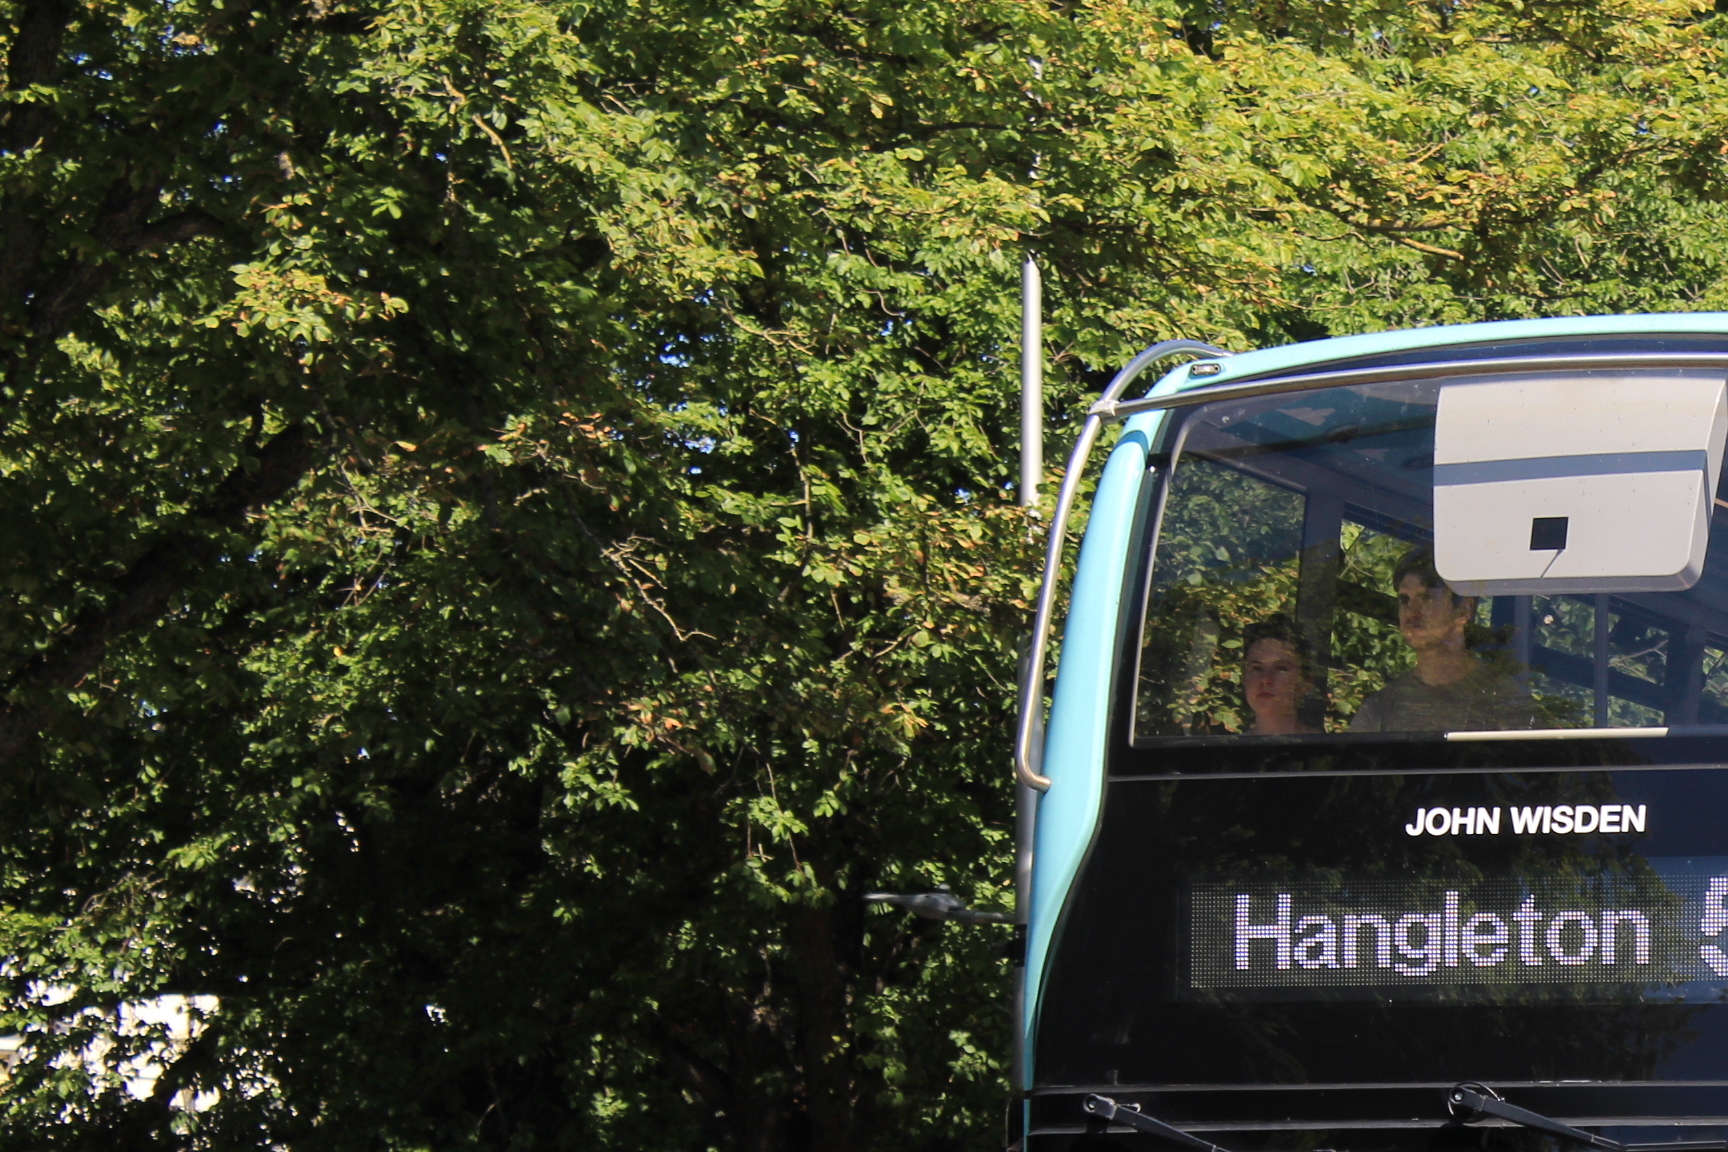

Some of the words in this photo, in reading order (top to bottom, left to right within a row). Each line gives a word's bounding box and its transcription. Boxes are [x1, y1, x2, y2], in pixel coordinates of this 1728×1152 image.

[1405, 806, 1501, 836] JOHN
[1510, 804, 1646, 835] WISDEN
[1234, 891, 1650, 977] Hangleton
